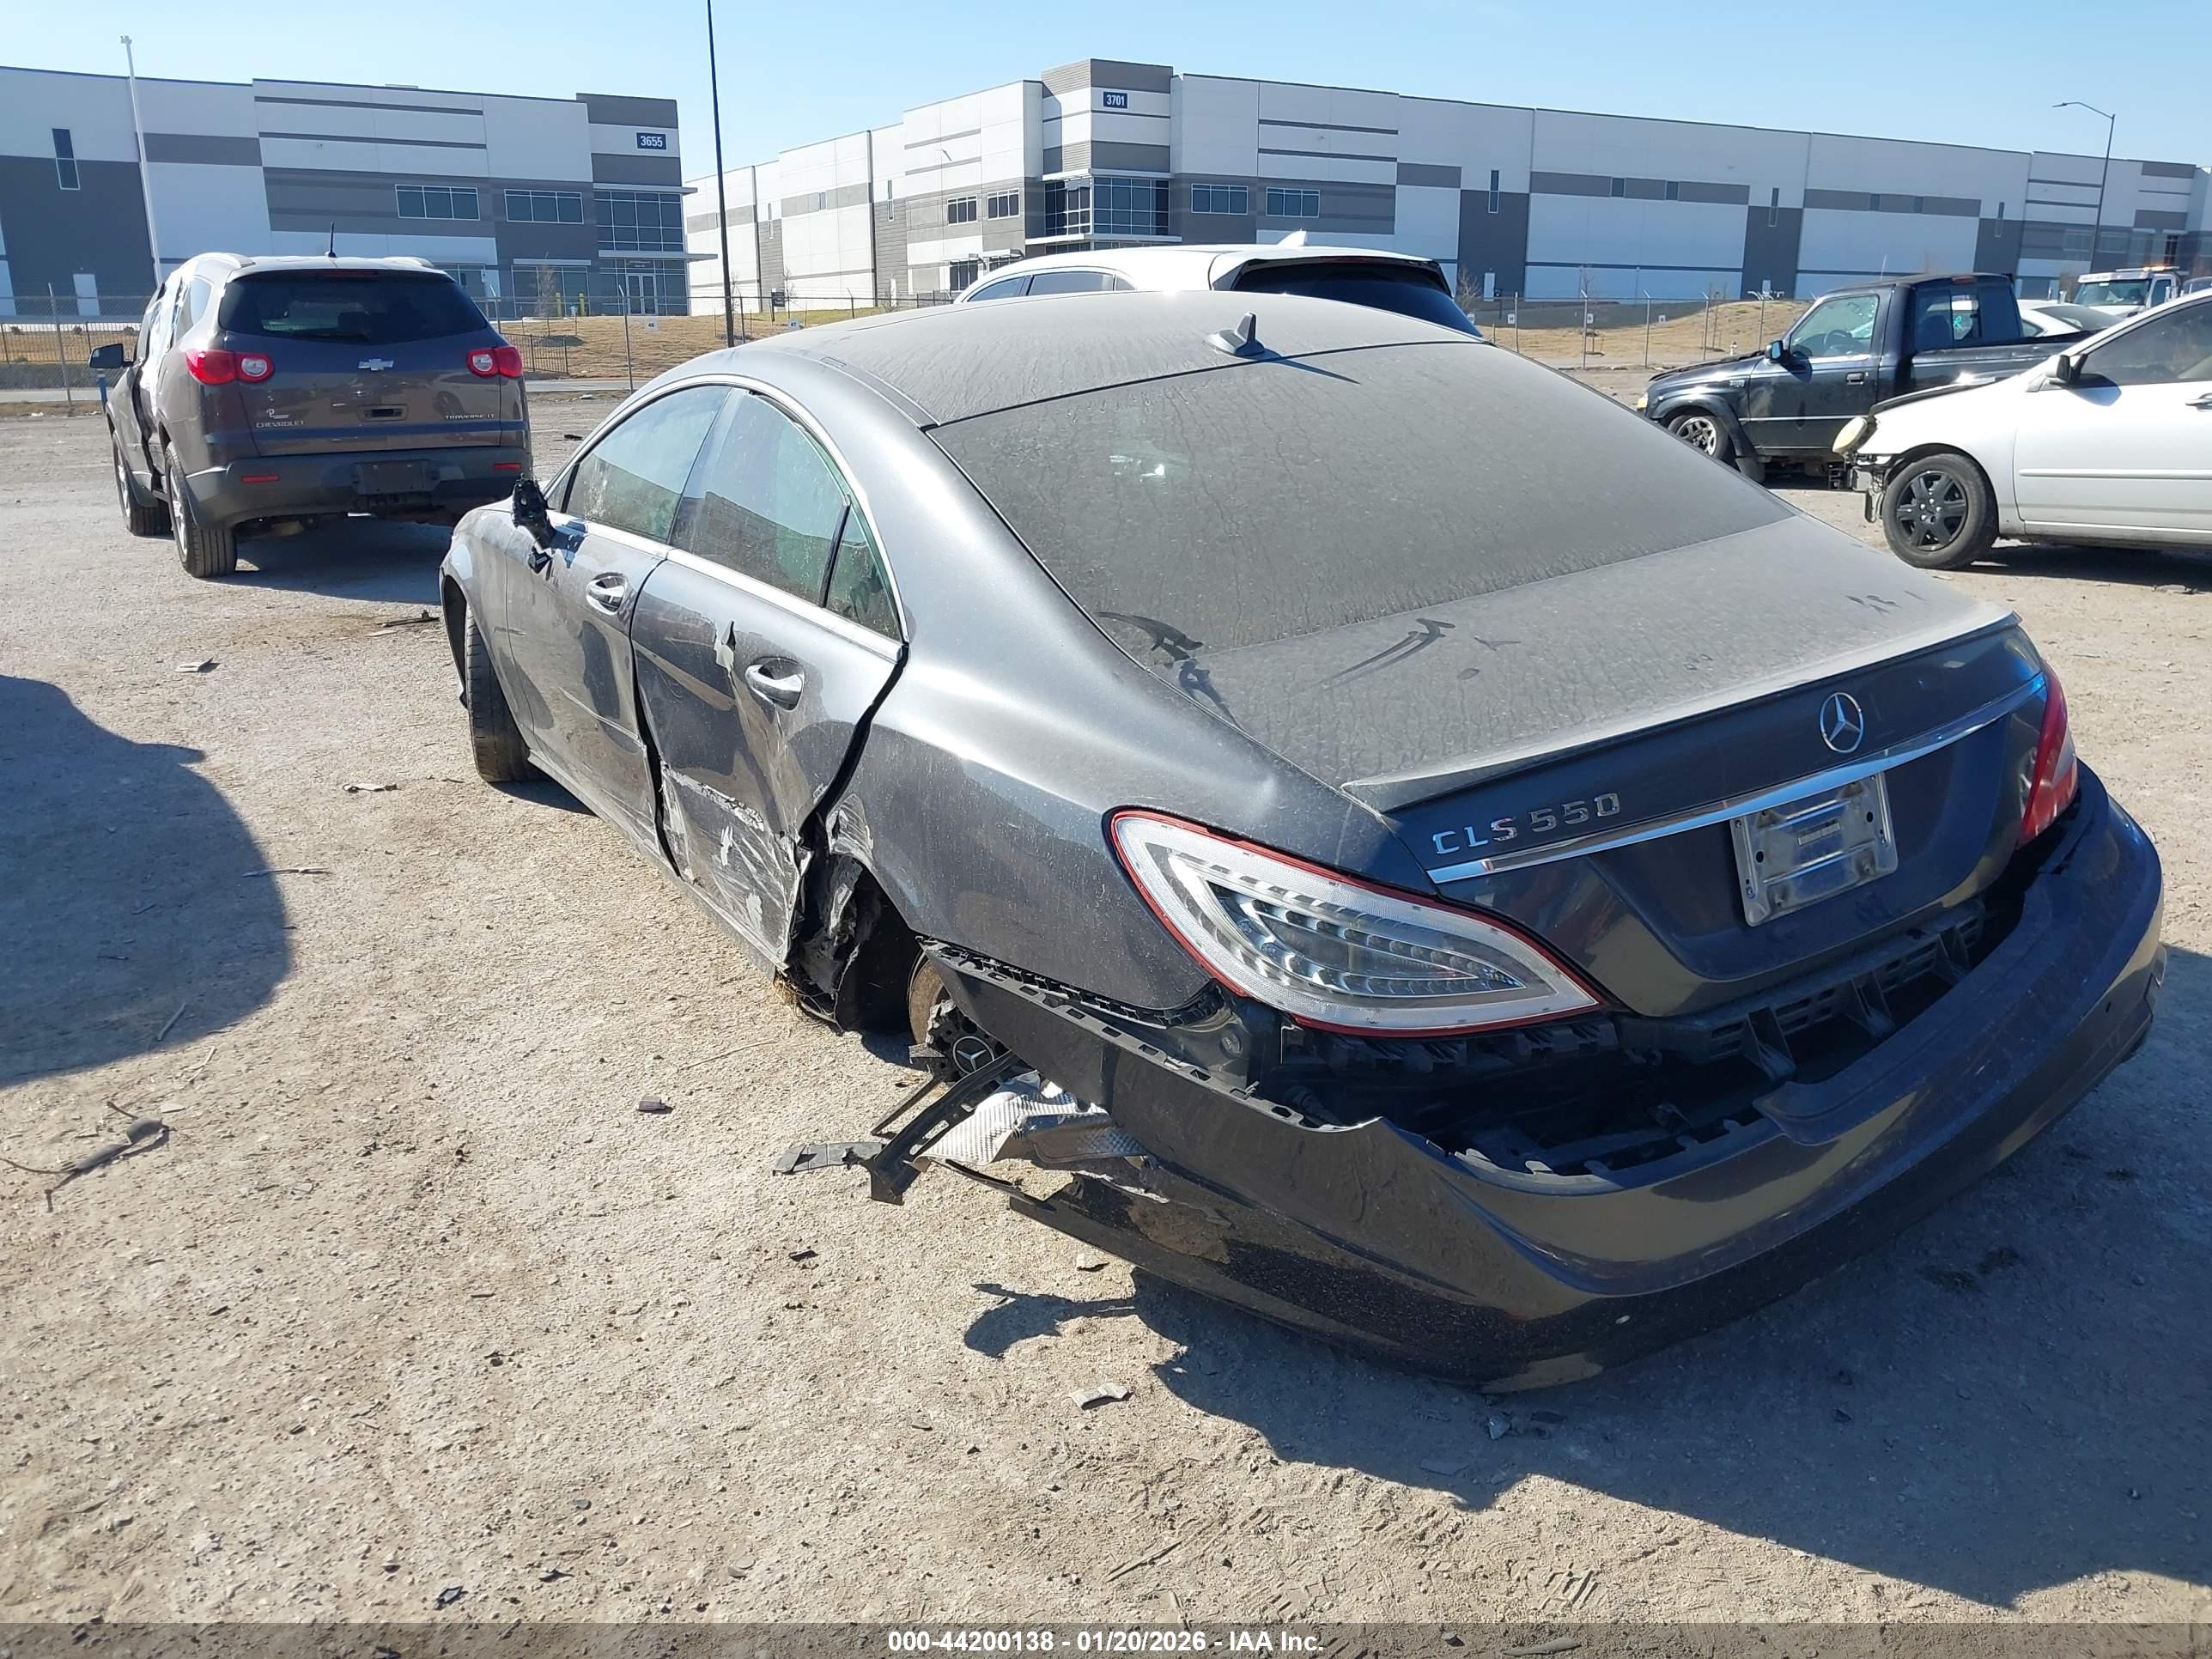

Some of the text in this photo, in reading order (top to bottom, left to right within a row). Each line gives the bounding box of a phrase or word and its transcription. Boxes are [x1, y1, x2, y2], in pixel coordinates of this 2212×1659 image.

[1107, 94, 1125, 106] 3701
[641, 136, 663, 147] 3655
[1432, 793, 1621, 854] CLS 550
